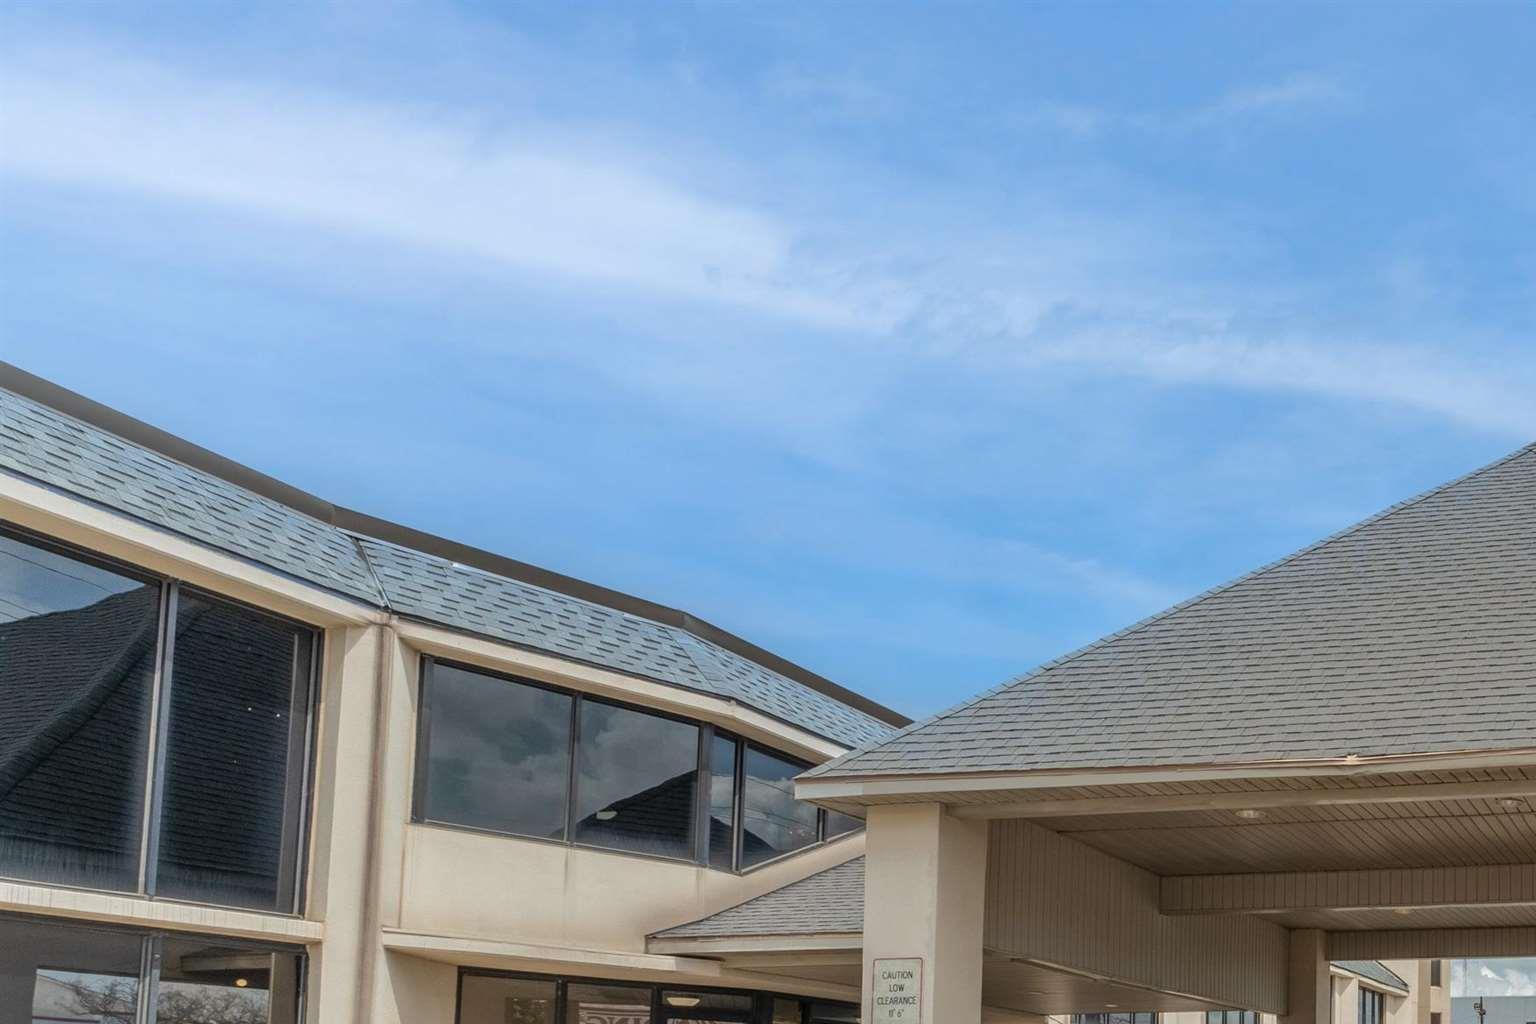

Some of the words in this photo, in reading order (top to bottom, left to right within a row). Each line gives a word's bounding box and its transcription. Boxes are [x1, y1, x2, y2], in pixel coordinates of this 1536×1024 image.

[881, 970, 913, 980] CAUTION
[888, 983, 905, 992] LOW
[876, 996, 917, 1005] CLEARANCE
